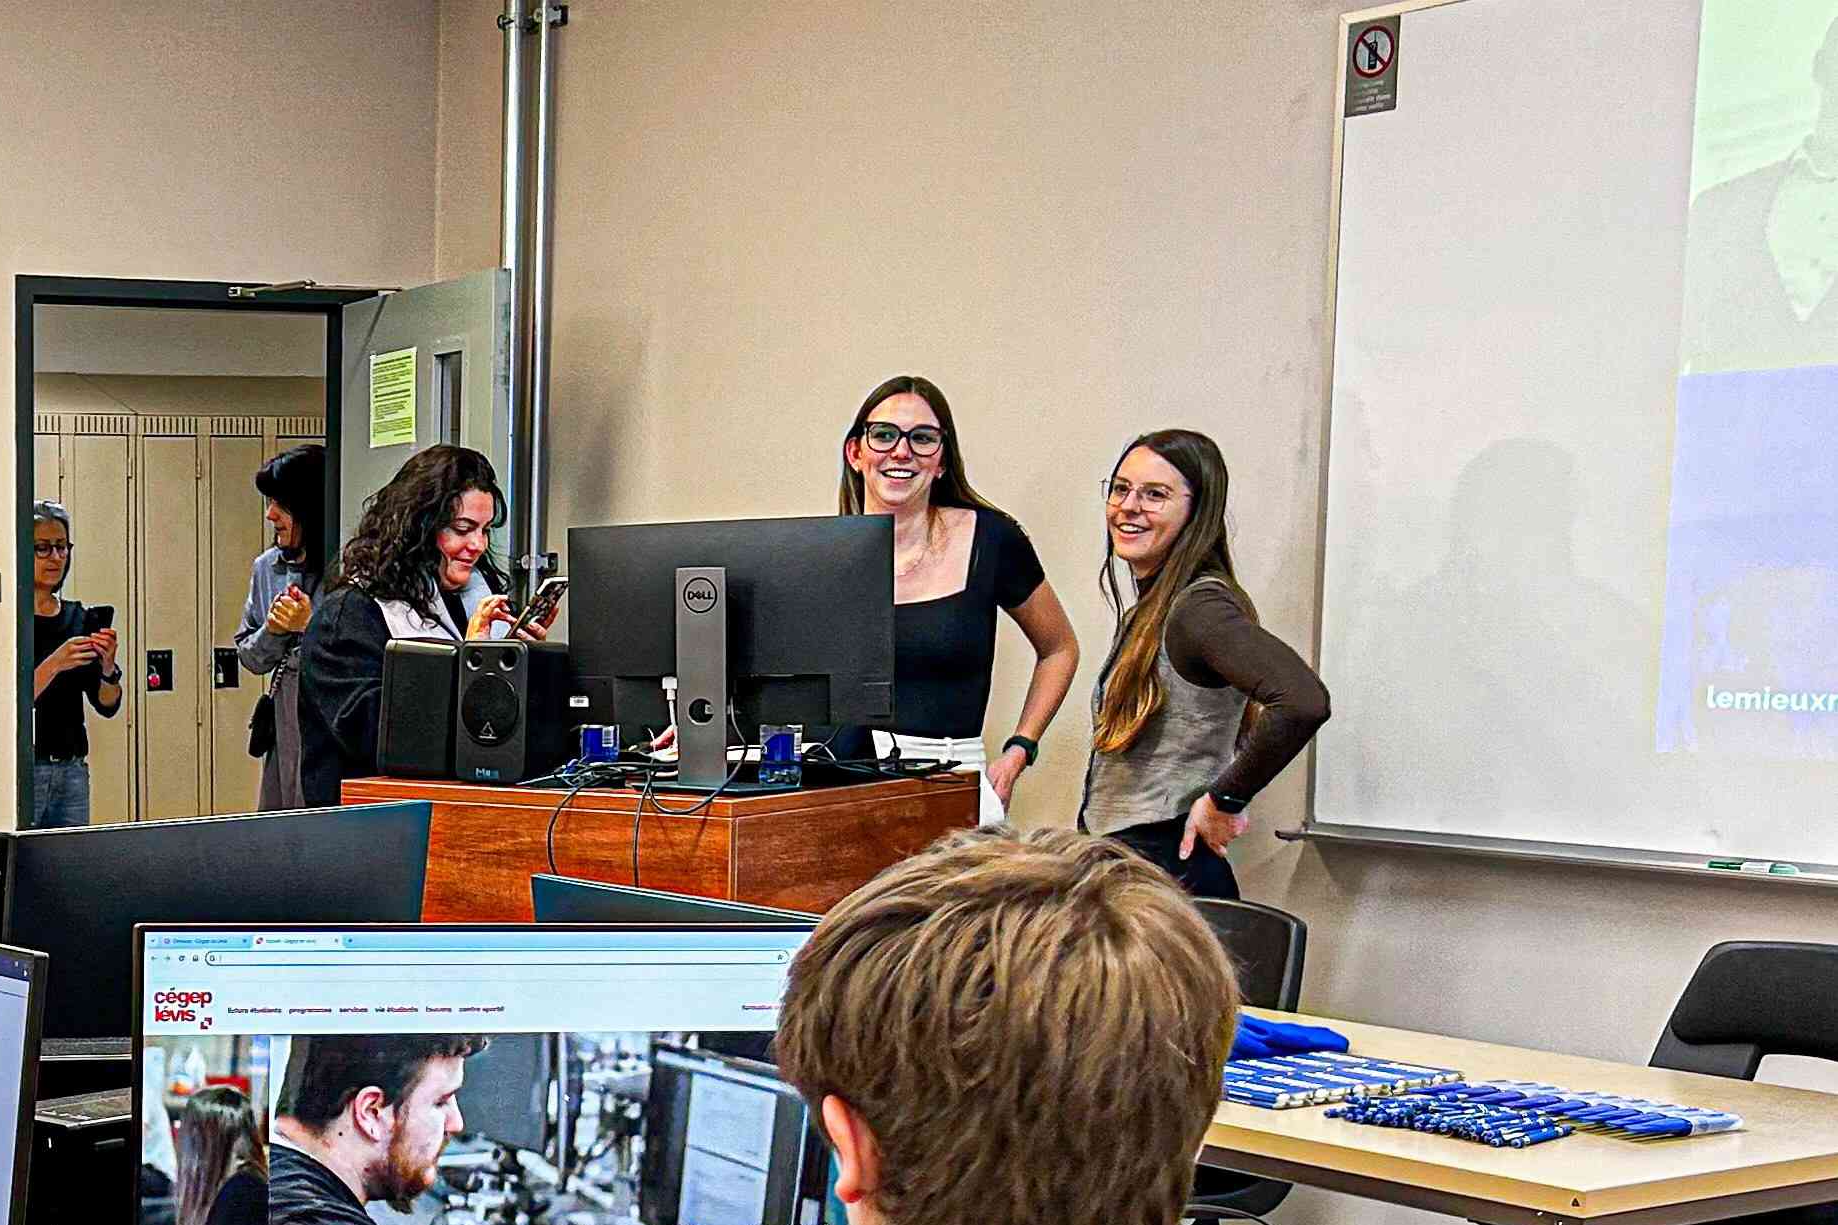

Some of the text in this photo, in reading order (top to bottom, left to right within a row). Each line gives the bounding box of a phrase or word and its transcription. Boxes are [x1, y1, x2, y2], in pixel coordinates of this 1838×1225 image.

[687, 590, 714, 600] DELL
[153, 987, 213, 1008] cégep
[154, 1006, 196, 1022] lévis
